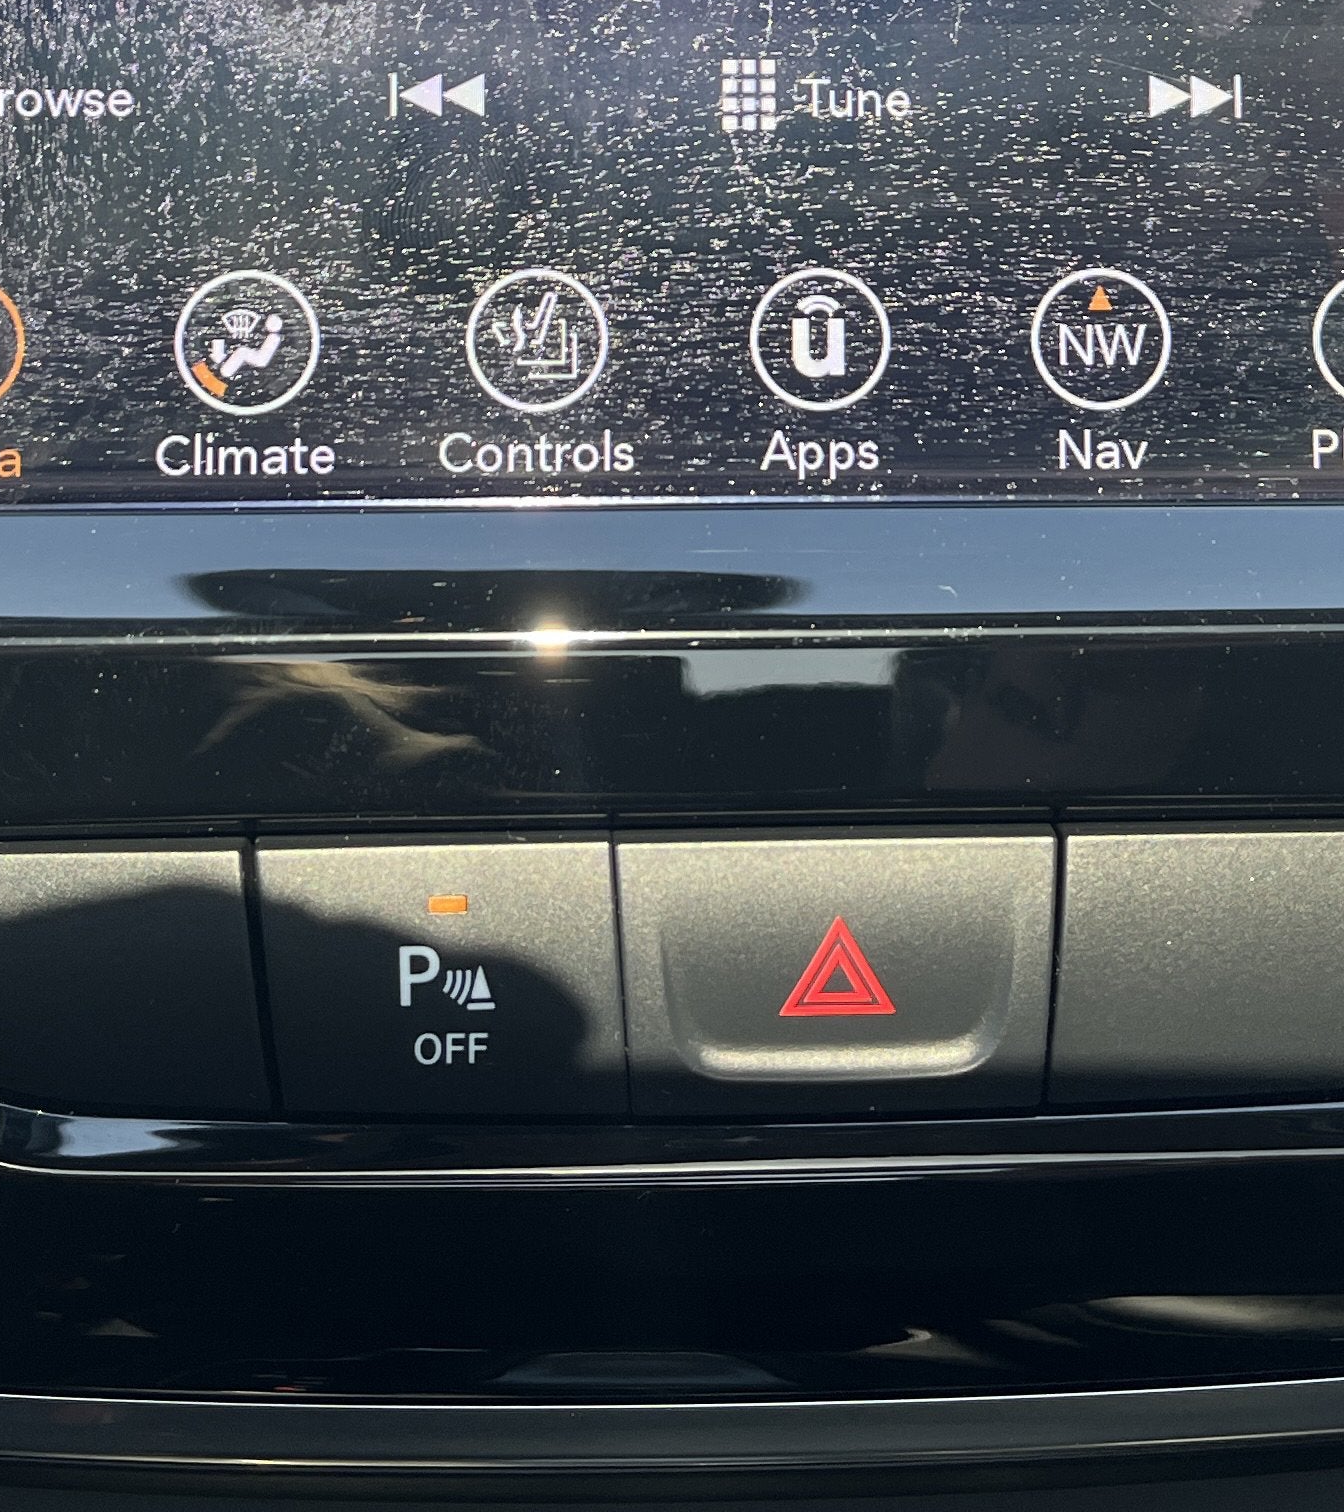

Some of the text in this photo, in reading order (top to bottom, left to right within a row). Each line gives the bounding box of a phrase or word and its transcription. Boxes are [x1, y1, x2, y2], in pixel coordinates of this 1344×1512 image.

[800, 82, 912, 120] Tune
[1057, 326, 1145, 368] NW
[155, 434, 336, 477] Climate
[438, 432, 636, 476] Controls
[760, 432, 880, 475] Apps
[1056, 431, 1148, 471] Nav
[399, 945, 441, 1007] P
[413, 1033, 489, 1065] OFF
